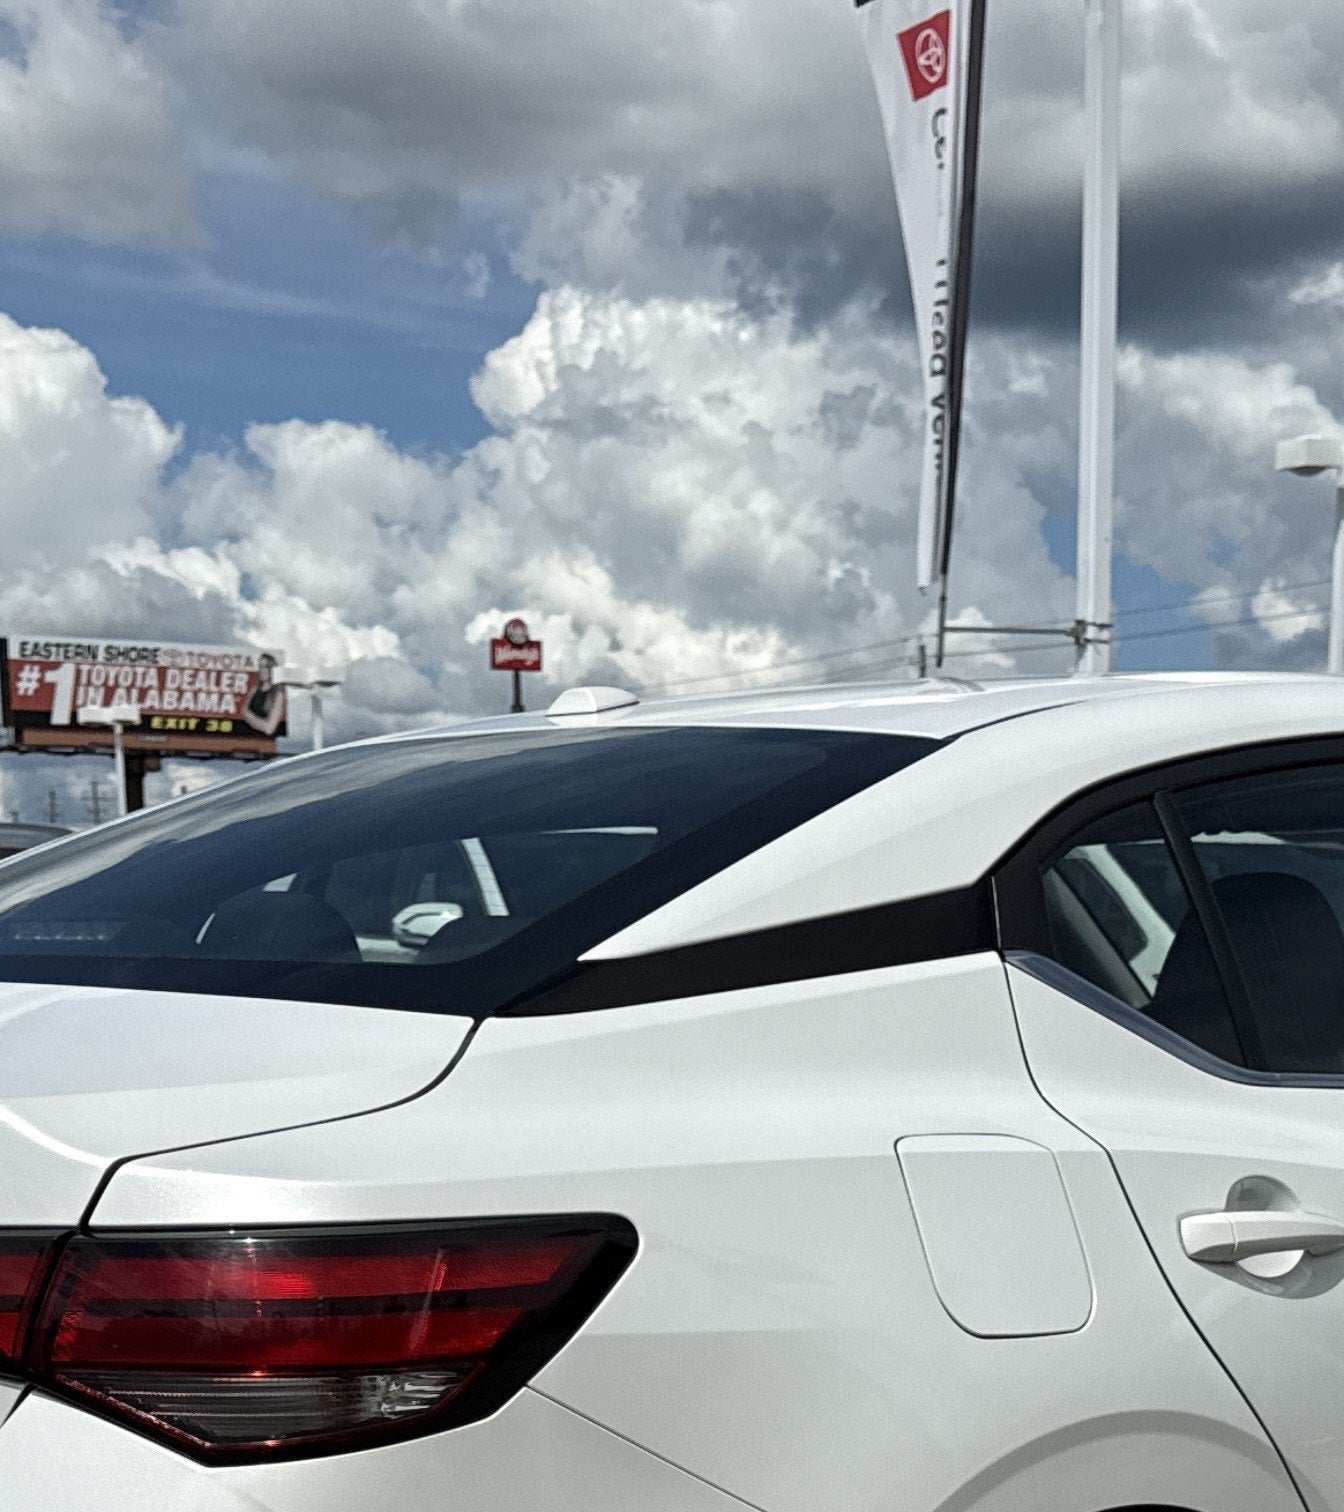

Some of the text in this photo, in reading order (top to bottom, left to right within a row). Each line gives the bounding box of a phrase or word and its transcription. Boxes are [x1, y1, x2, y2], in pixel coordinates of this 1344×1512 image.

[18, 641, 254, 670] EASTERN SHORE TOYOTA
[15, 662, 76, 726] #1
[78, 664, 250, 695] TOYOTA DEALER
[76, 685, 238, 714] IN ALABAMA
[150, 715, 201, 731] EXIT
